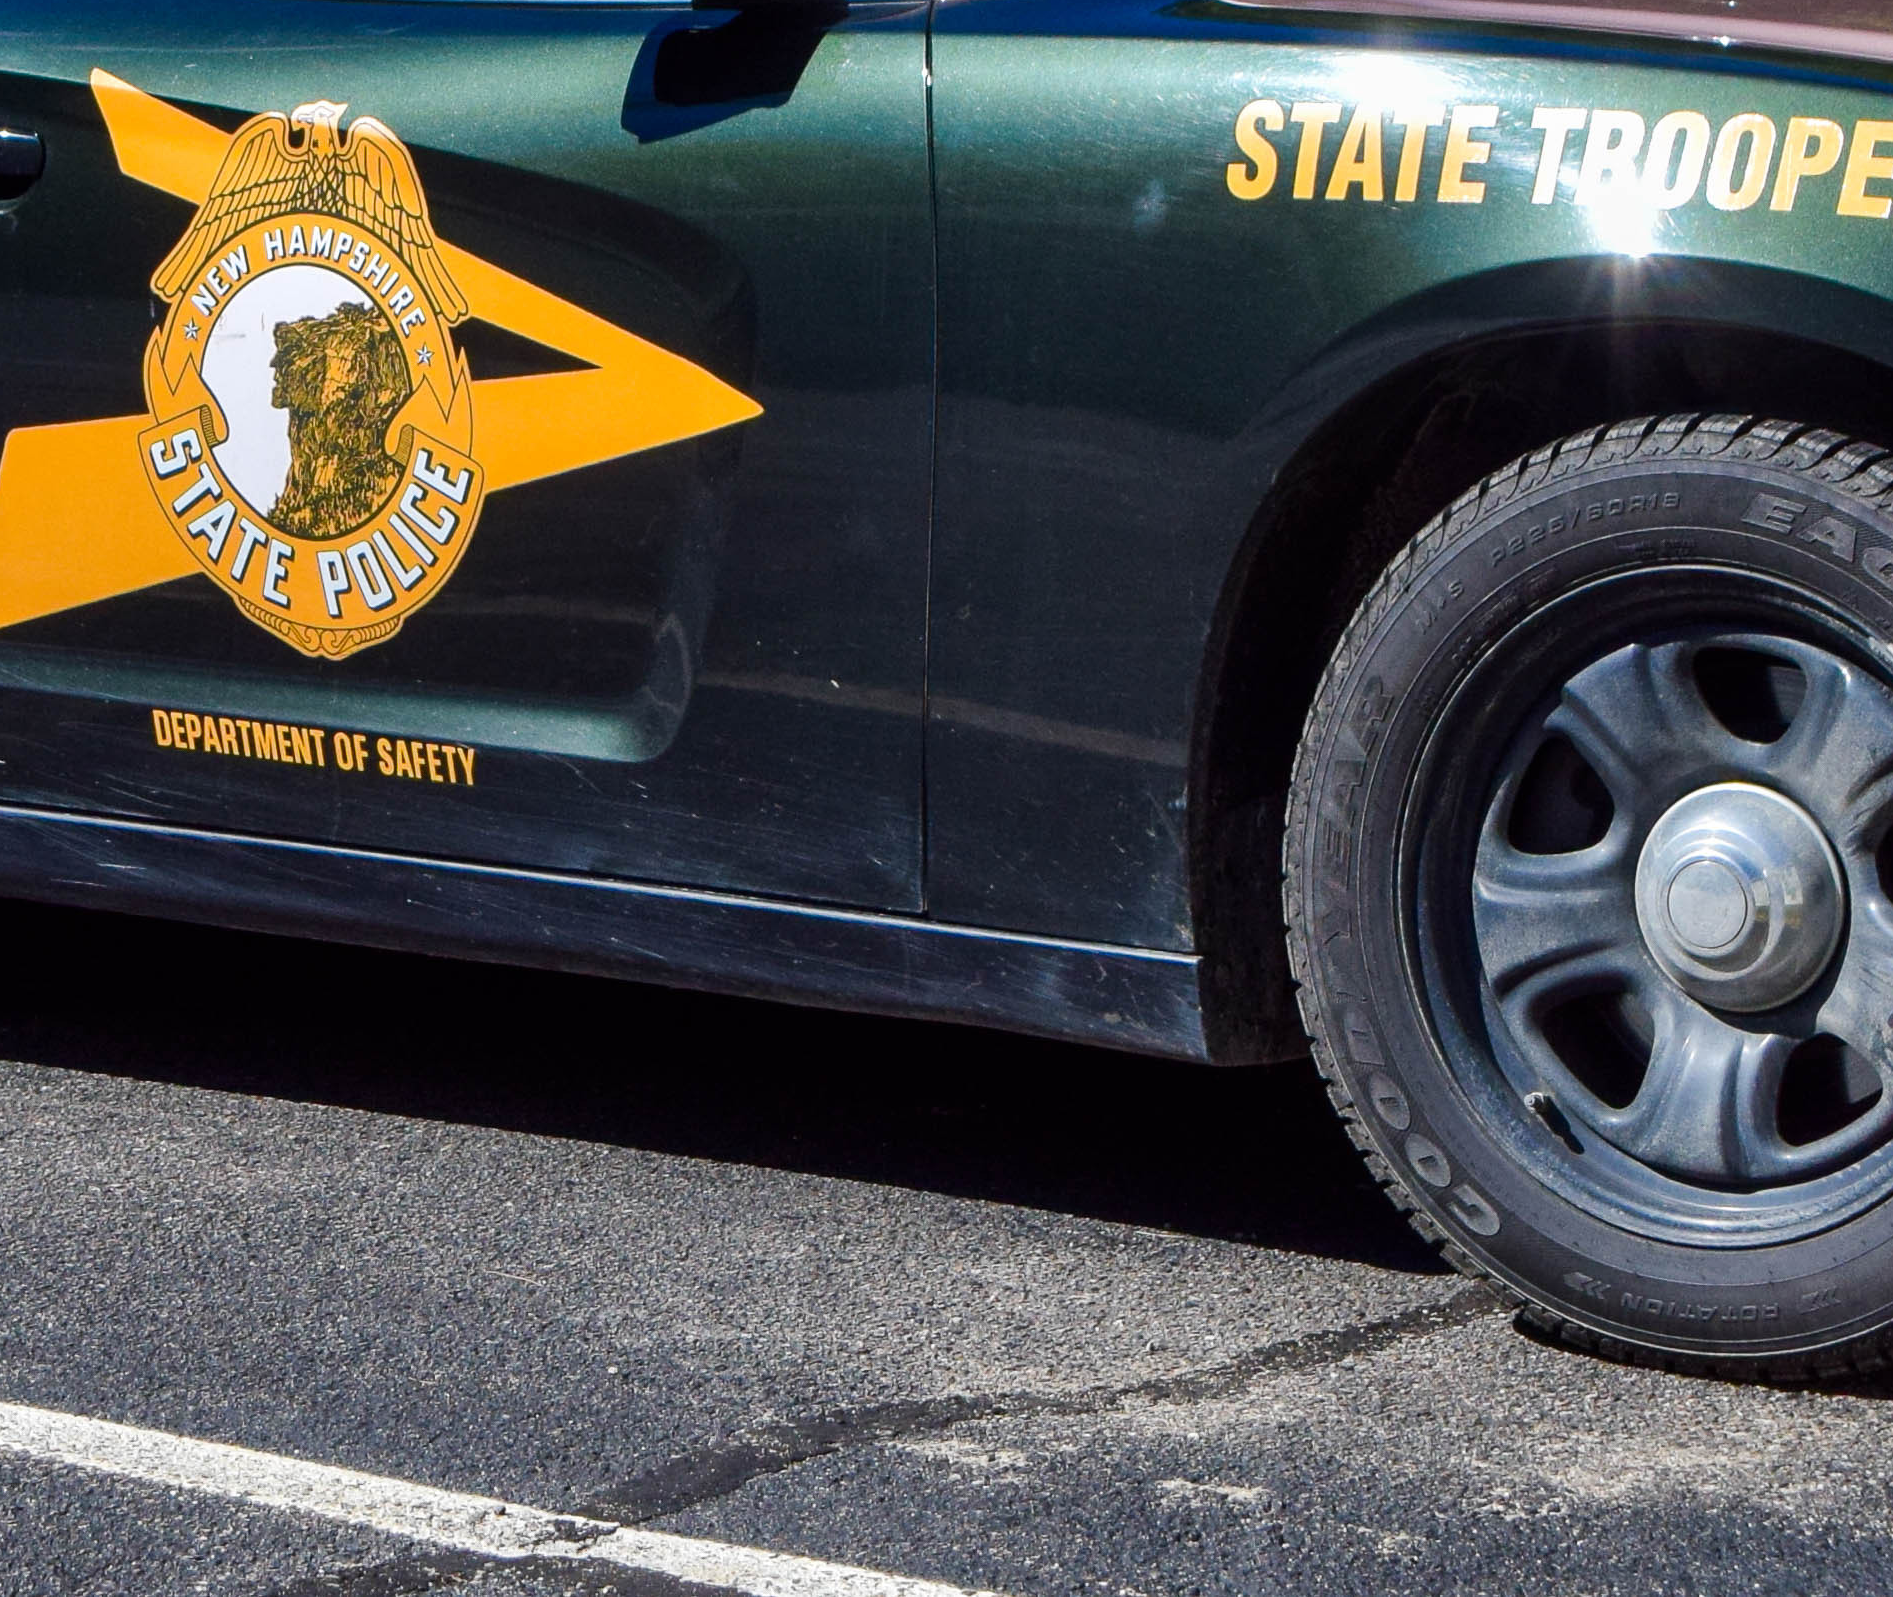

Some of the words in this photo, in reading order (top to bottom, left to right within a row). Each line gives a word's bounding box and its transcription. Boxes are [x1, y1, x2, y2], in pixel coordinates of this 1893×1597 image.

[1226, 98, 1500, 204] STATE
[190, 244, 250, 317] NEW
[264, 224, 426, 336] HAMPSHIRE
[149, 427, 294, 611] STATE
[316, 447, 476, 619] POLICE
[152, 709, 325, 767] DEPARTMENT
[333, 731, 368, 772] OF
[377, 738, 476, 786] SAFETY
